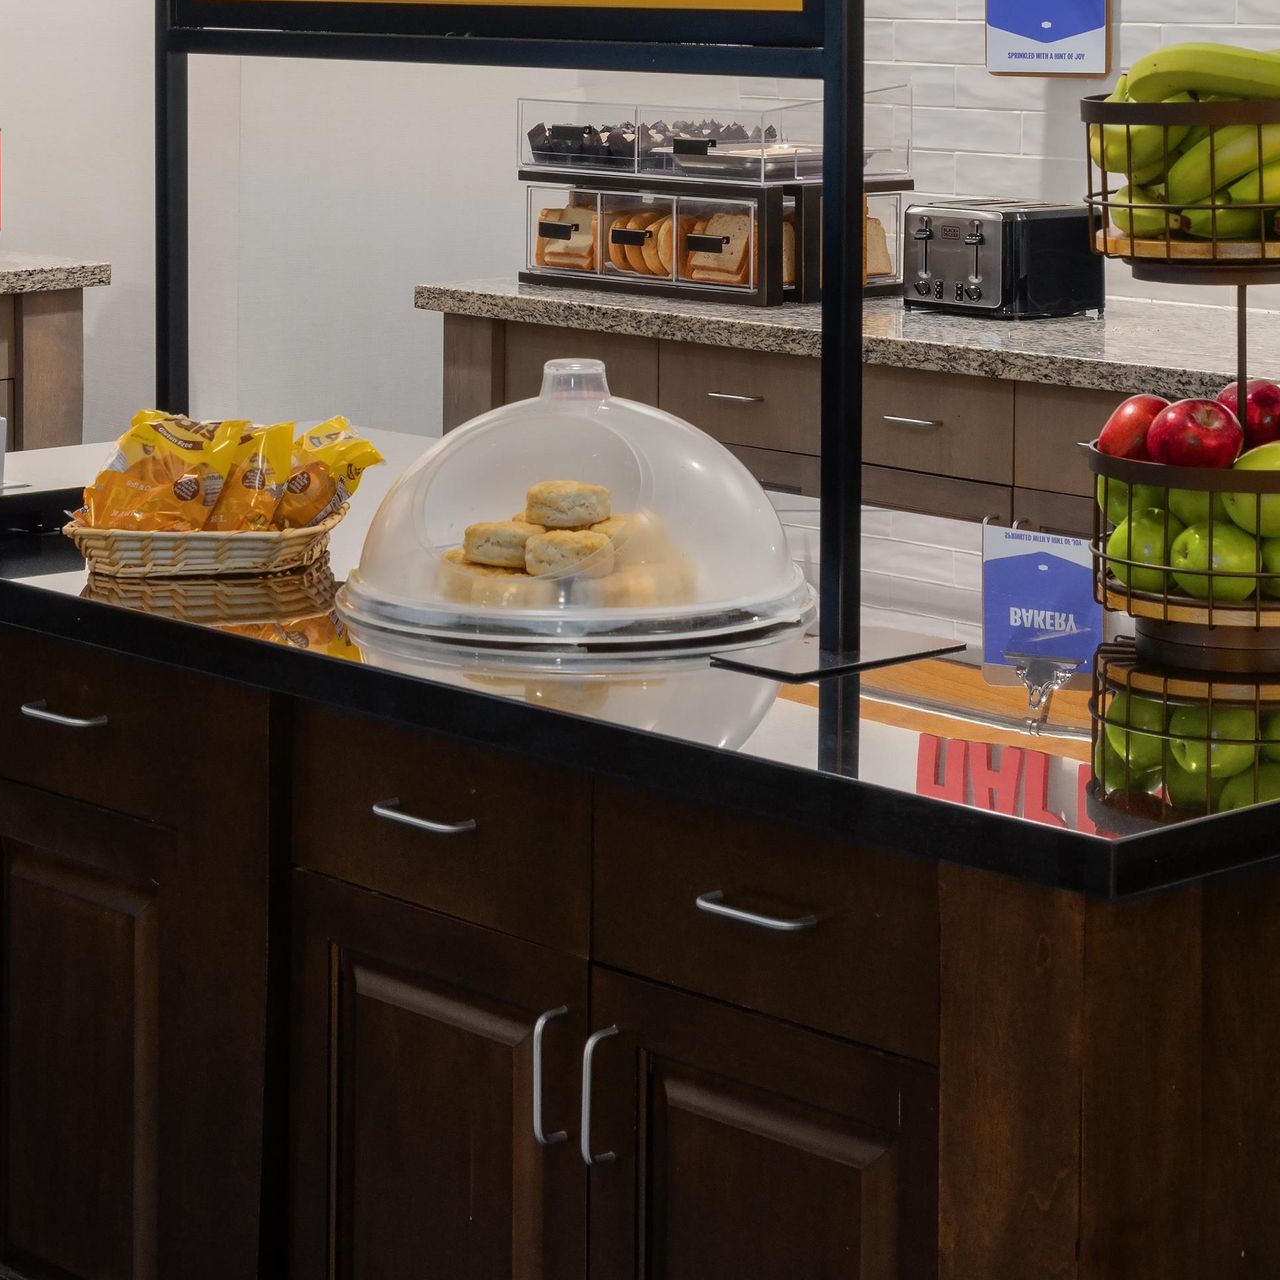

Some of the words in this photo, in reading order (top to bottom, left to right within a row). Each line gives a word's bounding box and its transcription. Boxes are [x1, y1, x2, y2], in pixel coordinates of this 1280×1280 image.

[1007, 51, 1035, 60] SPRINKLED
[1036, 52, 1049, 60] WITH
[1049, 52, 1054, 60] A
[1054, 52, 1066, 60] HINT
[1075, 53, 1086, 61] JOY
